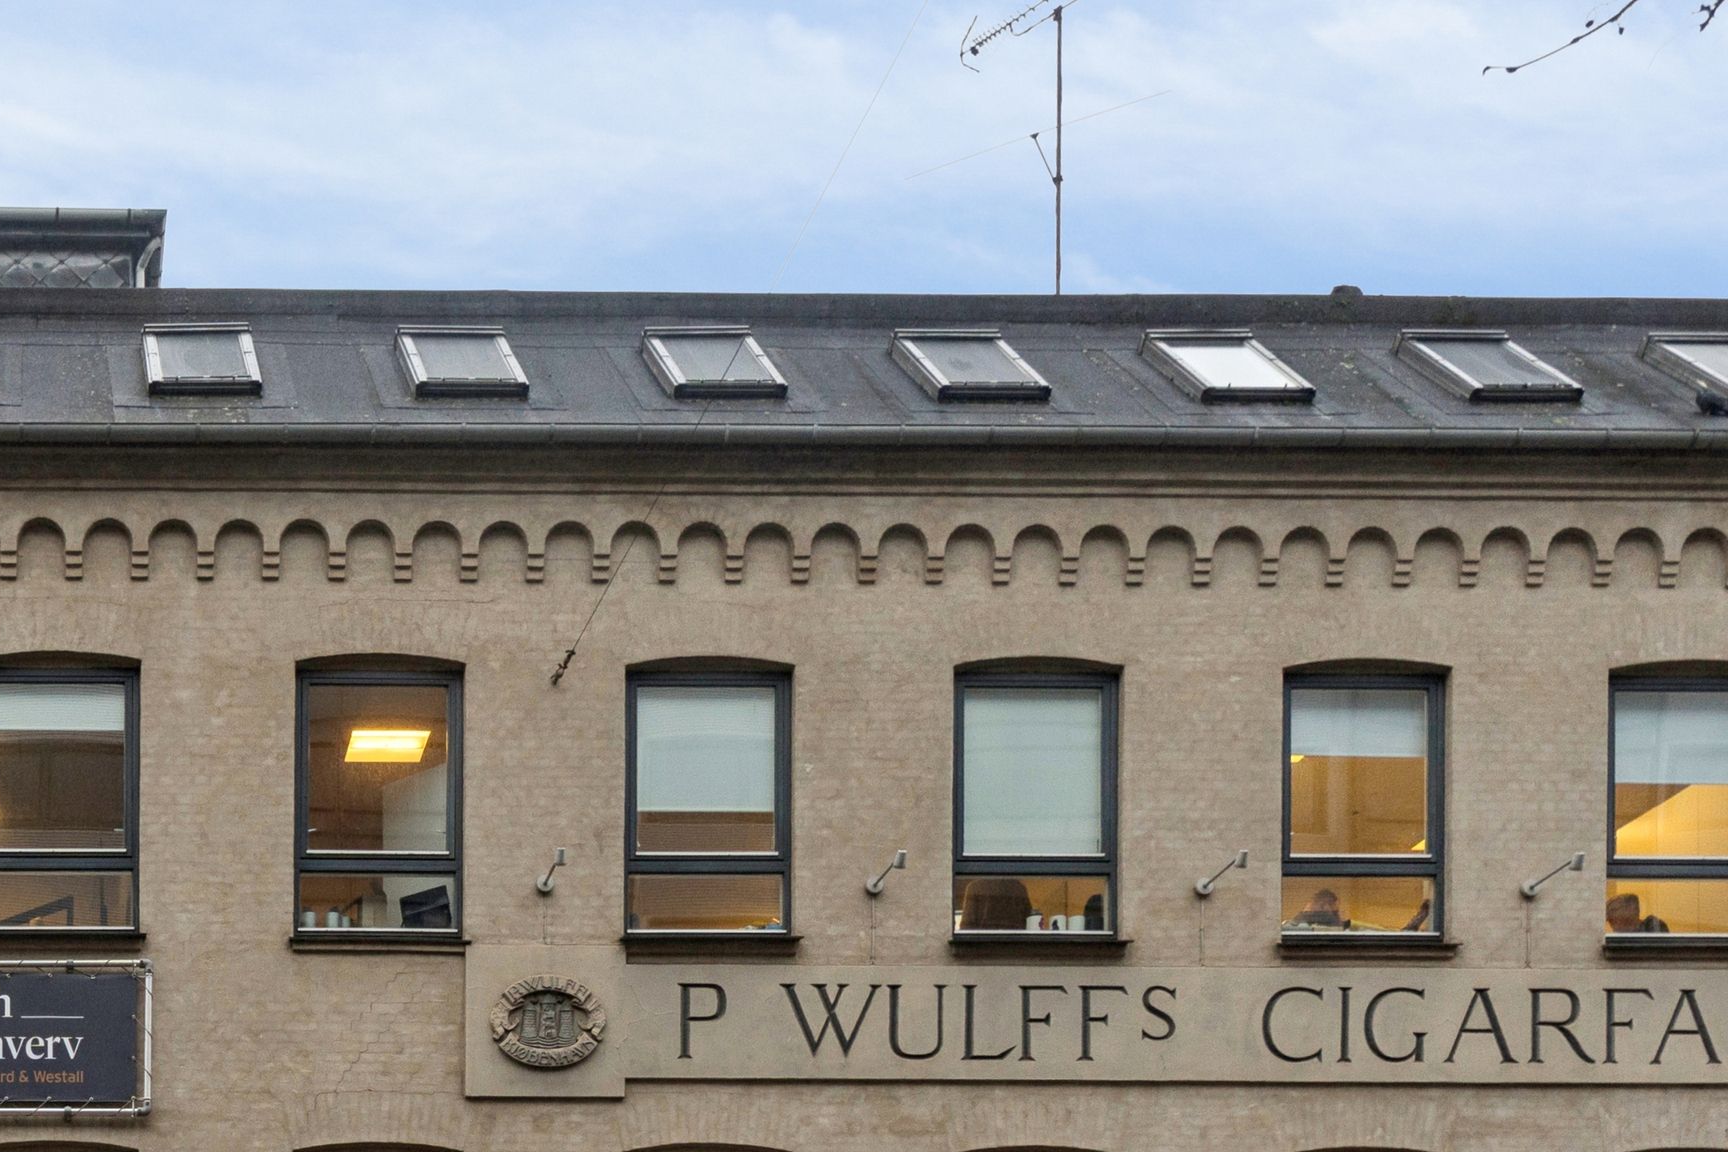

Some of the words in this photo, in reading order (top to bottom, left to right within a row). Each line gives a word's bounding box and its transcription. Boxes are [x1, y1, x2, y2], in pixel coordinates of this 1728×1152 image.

[678, 982, 726, 1060] P
[779, 982, 1177, 1062] WULFFS
[1262, 985, 1722, 1065] CIGARFA
[18, 1070, 29, 1084] &
[33, 1070, 84, 1084] Westall
